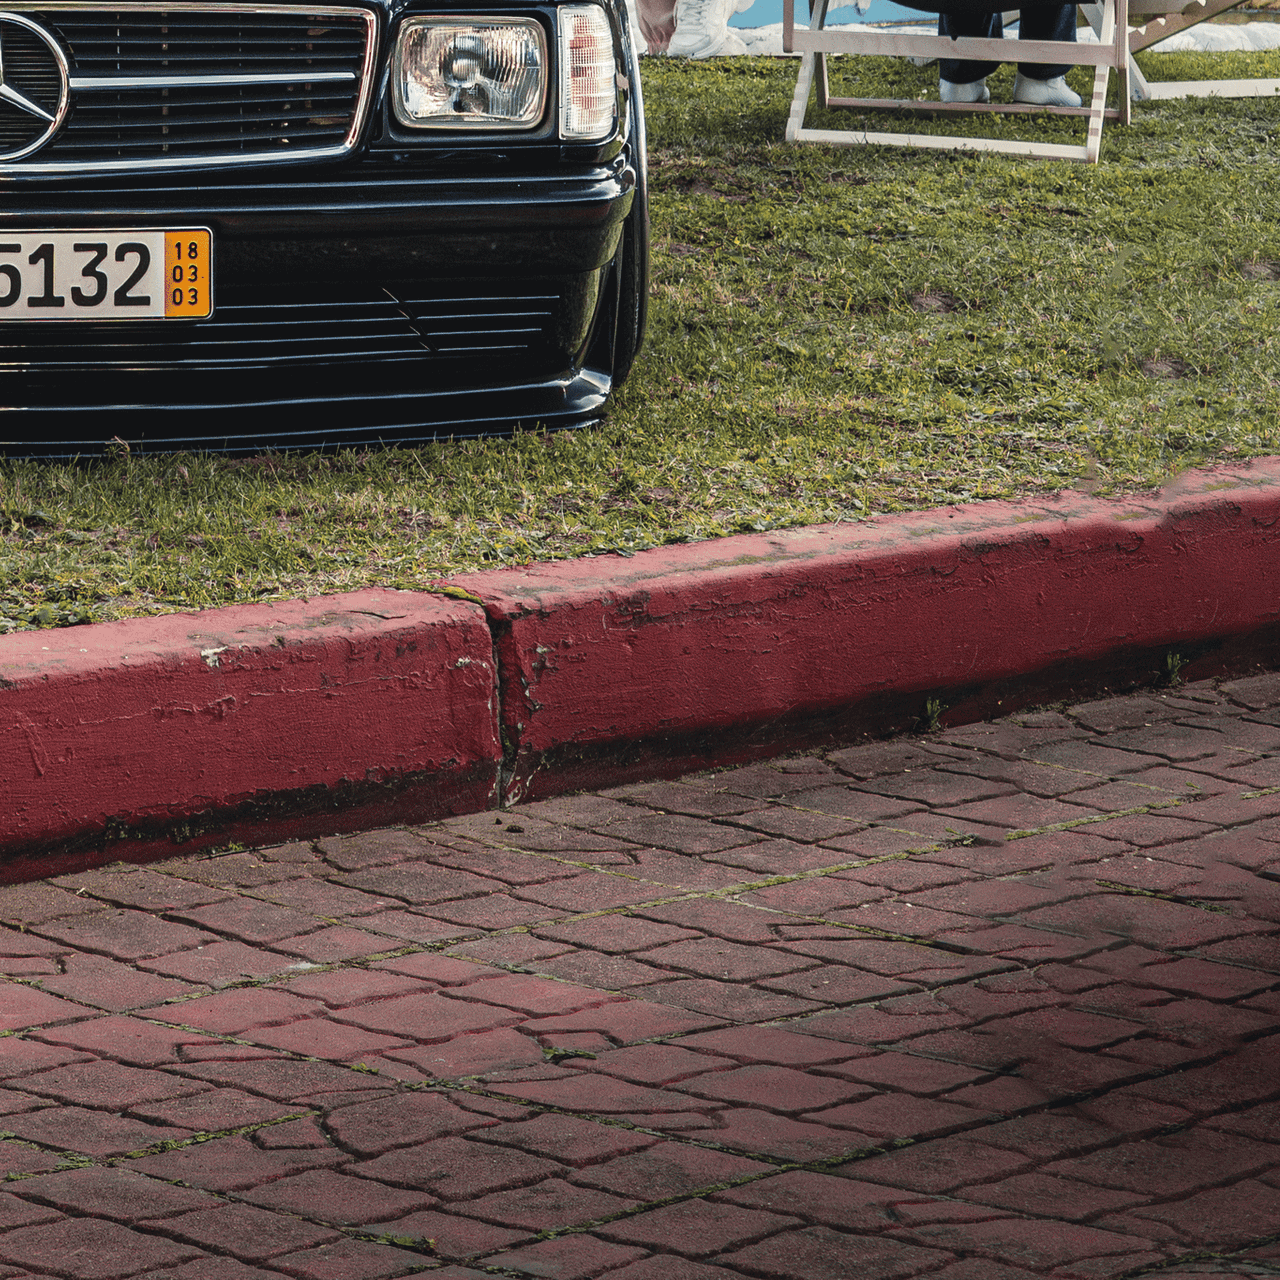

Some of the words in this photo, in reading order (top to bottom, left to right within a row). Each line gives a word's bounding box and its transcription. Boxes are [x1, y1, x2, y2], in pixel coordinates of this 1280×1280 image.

[174, 241, 198, 260] 18
[172, 264, 198, 283] 03
[172, 287, 198, 306] 03
